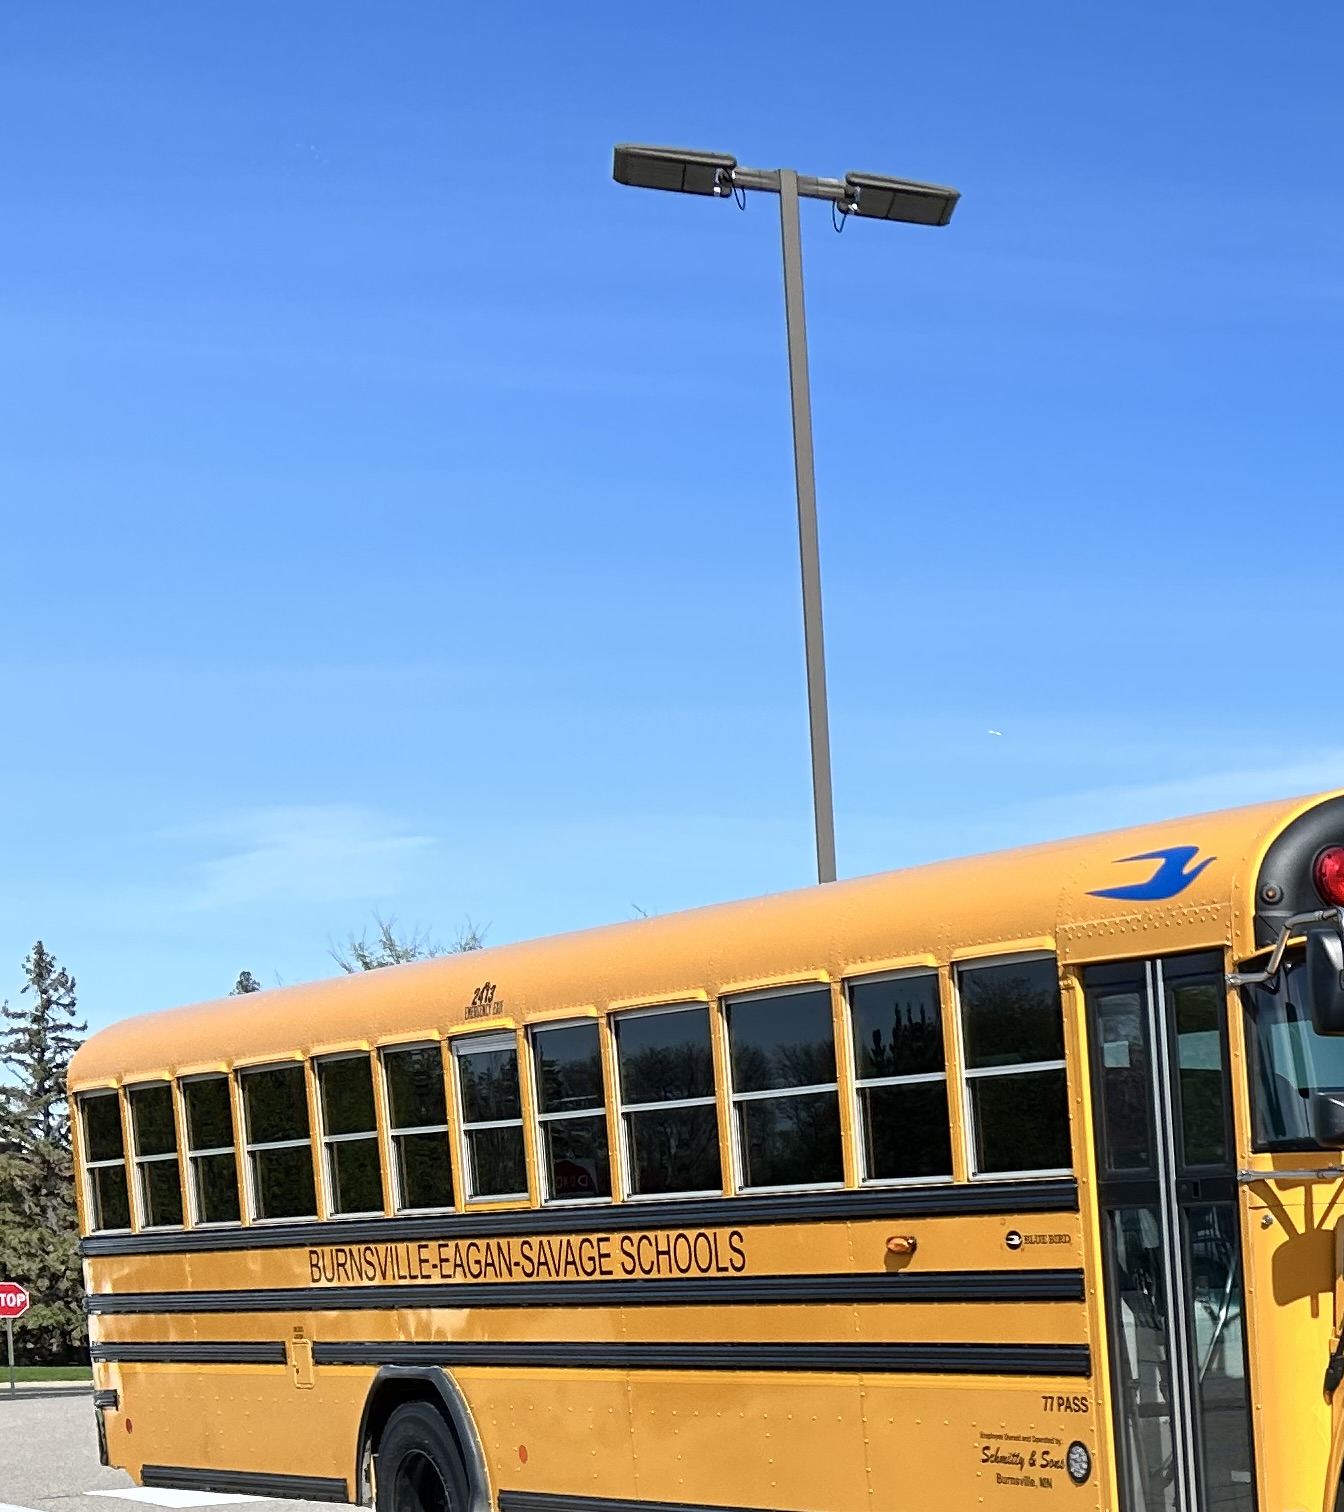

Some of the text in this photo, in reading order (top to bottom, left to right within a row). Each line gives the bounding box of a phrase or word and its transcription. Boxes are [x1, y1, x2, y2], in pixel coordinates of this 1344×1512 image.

[309, 1230, 746, 1283] BURNSVILLE-EAGAN-SAVAGE SCHOOLS
[0, 1293, 26, 1307] TOP
[1041, 1395, 1089, 1413] 77 PASS
[1029, 1450, 1036, 1467] &
[1039, 1450, 1064, 1469] Sons
